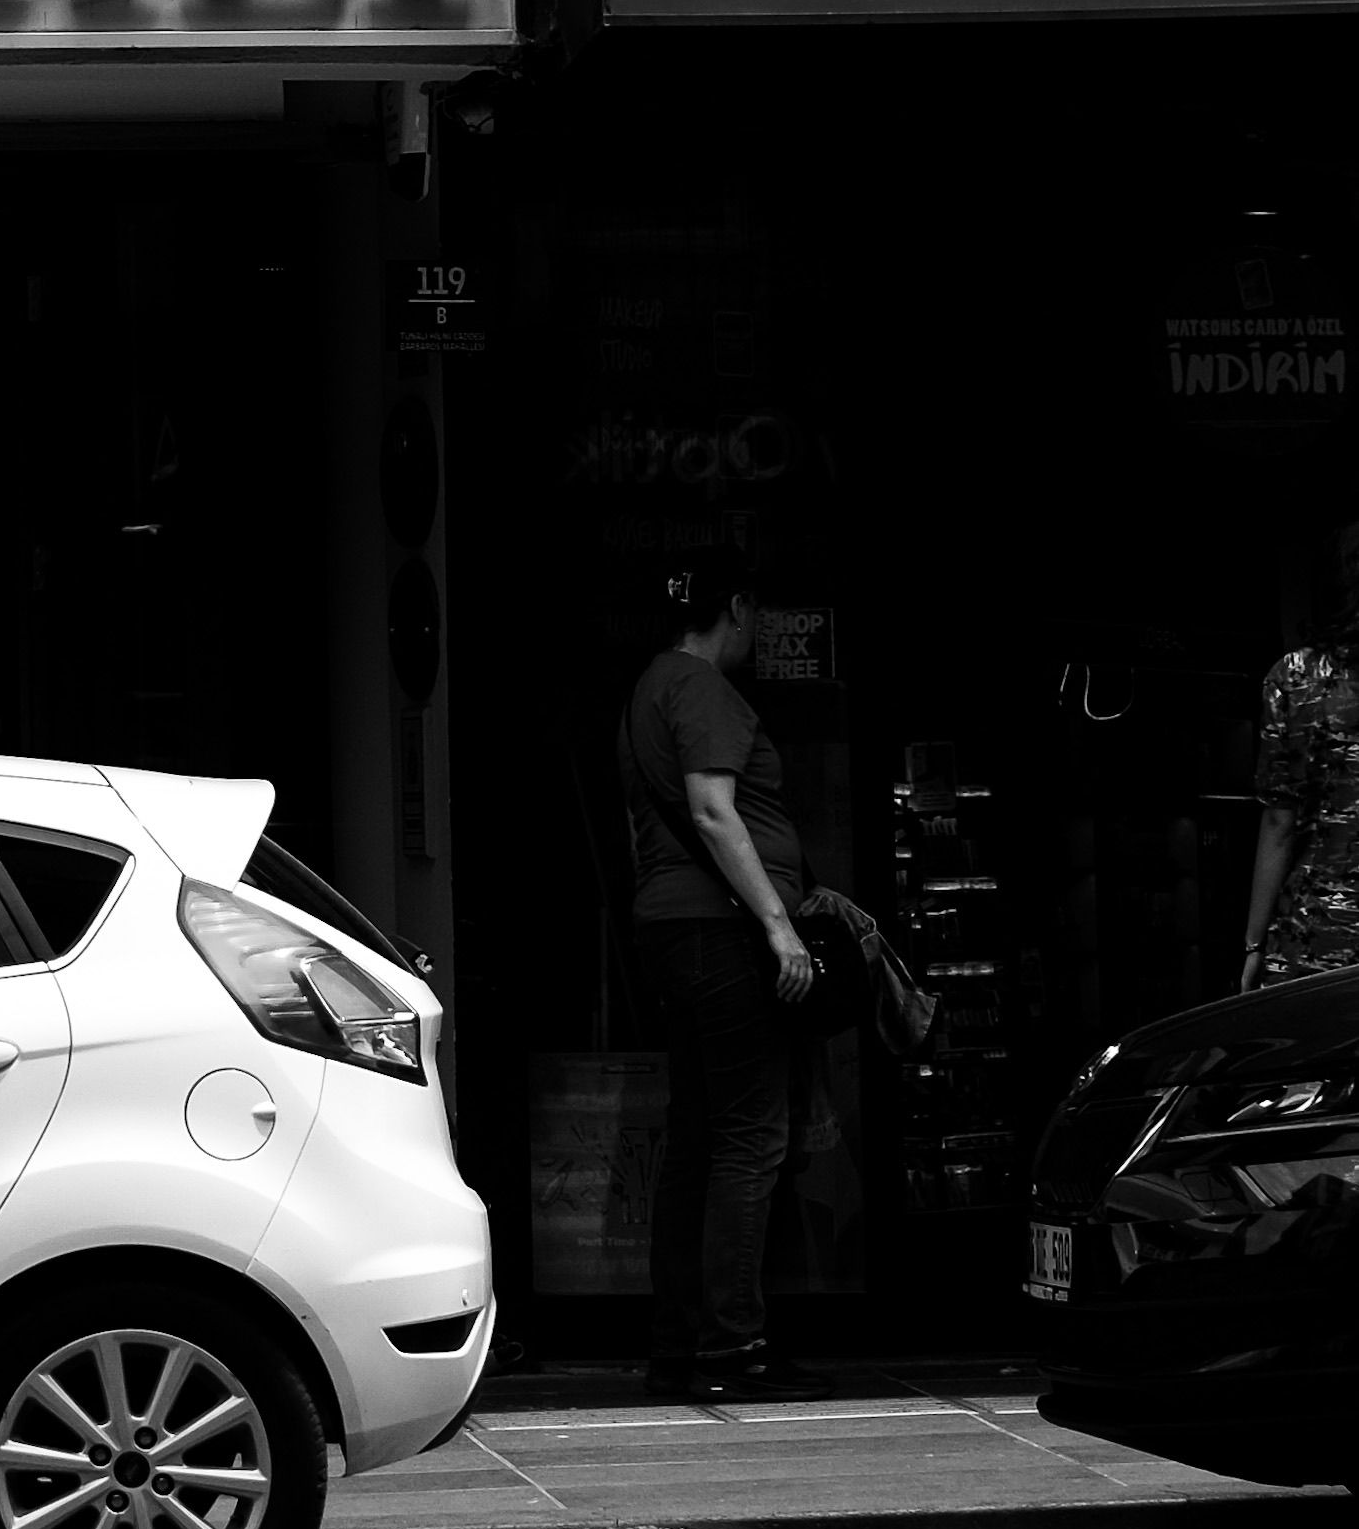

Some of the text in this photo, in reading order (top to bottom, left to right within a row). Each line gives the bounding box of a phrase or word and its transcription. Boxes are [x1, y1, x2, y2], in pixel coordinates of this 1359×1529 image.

[416, 266, 467, 295] 119
[436, 306, 448, 325] B
[1165, 317, 1241, 337] WATSONS
[1165, 340, 1347, 397] İNDİRİM
